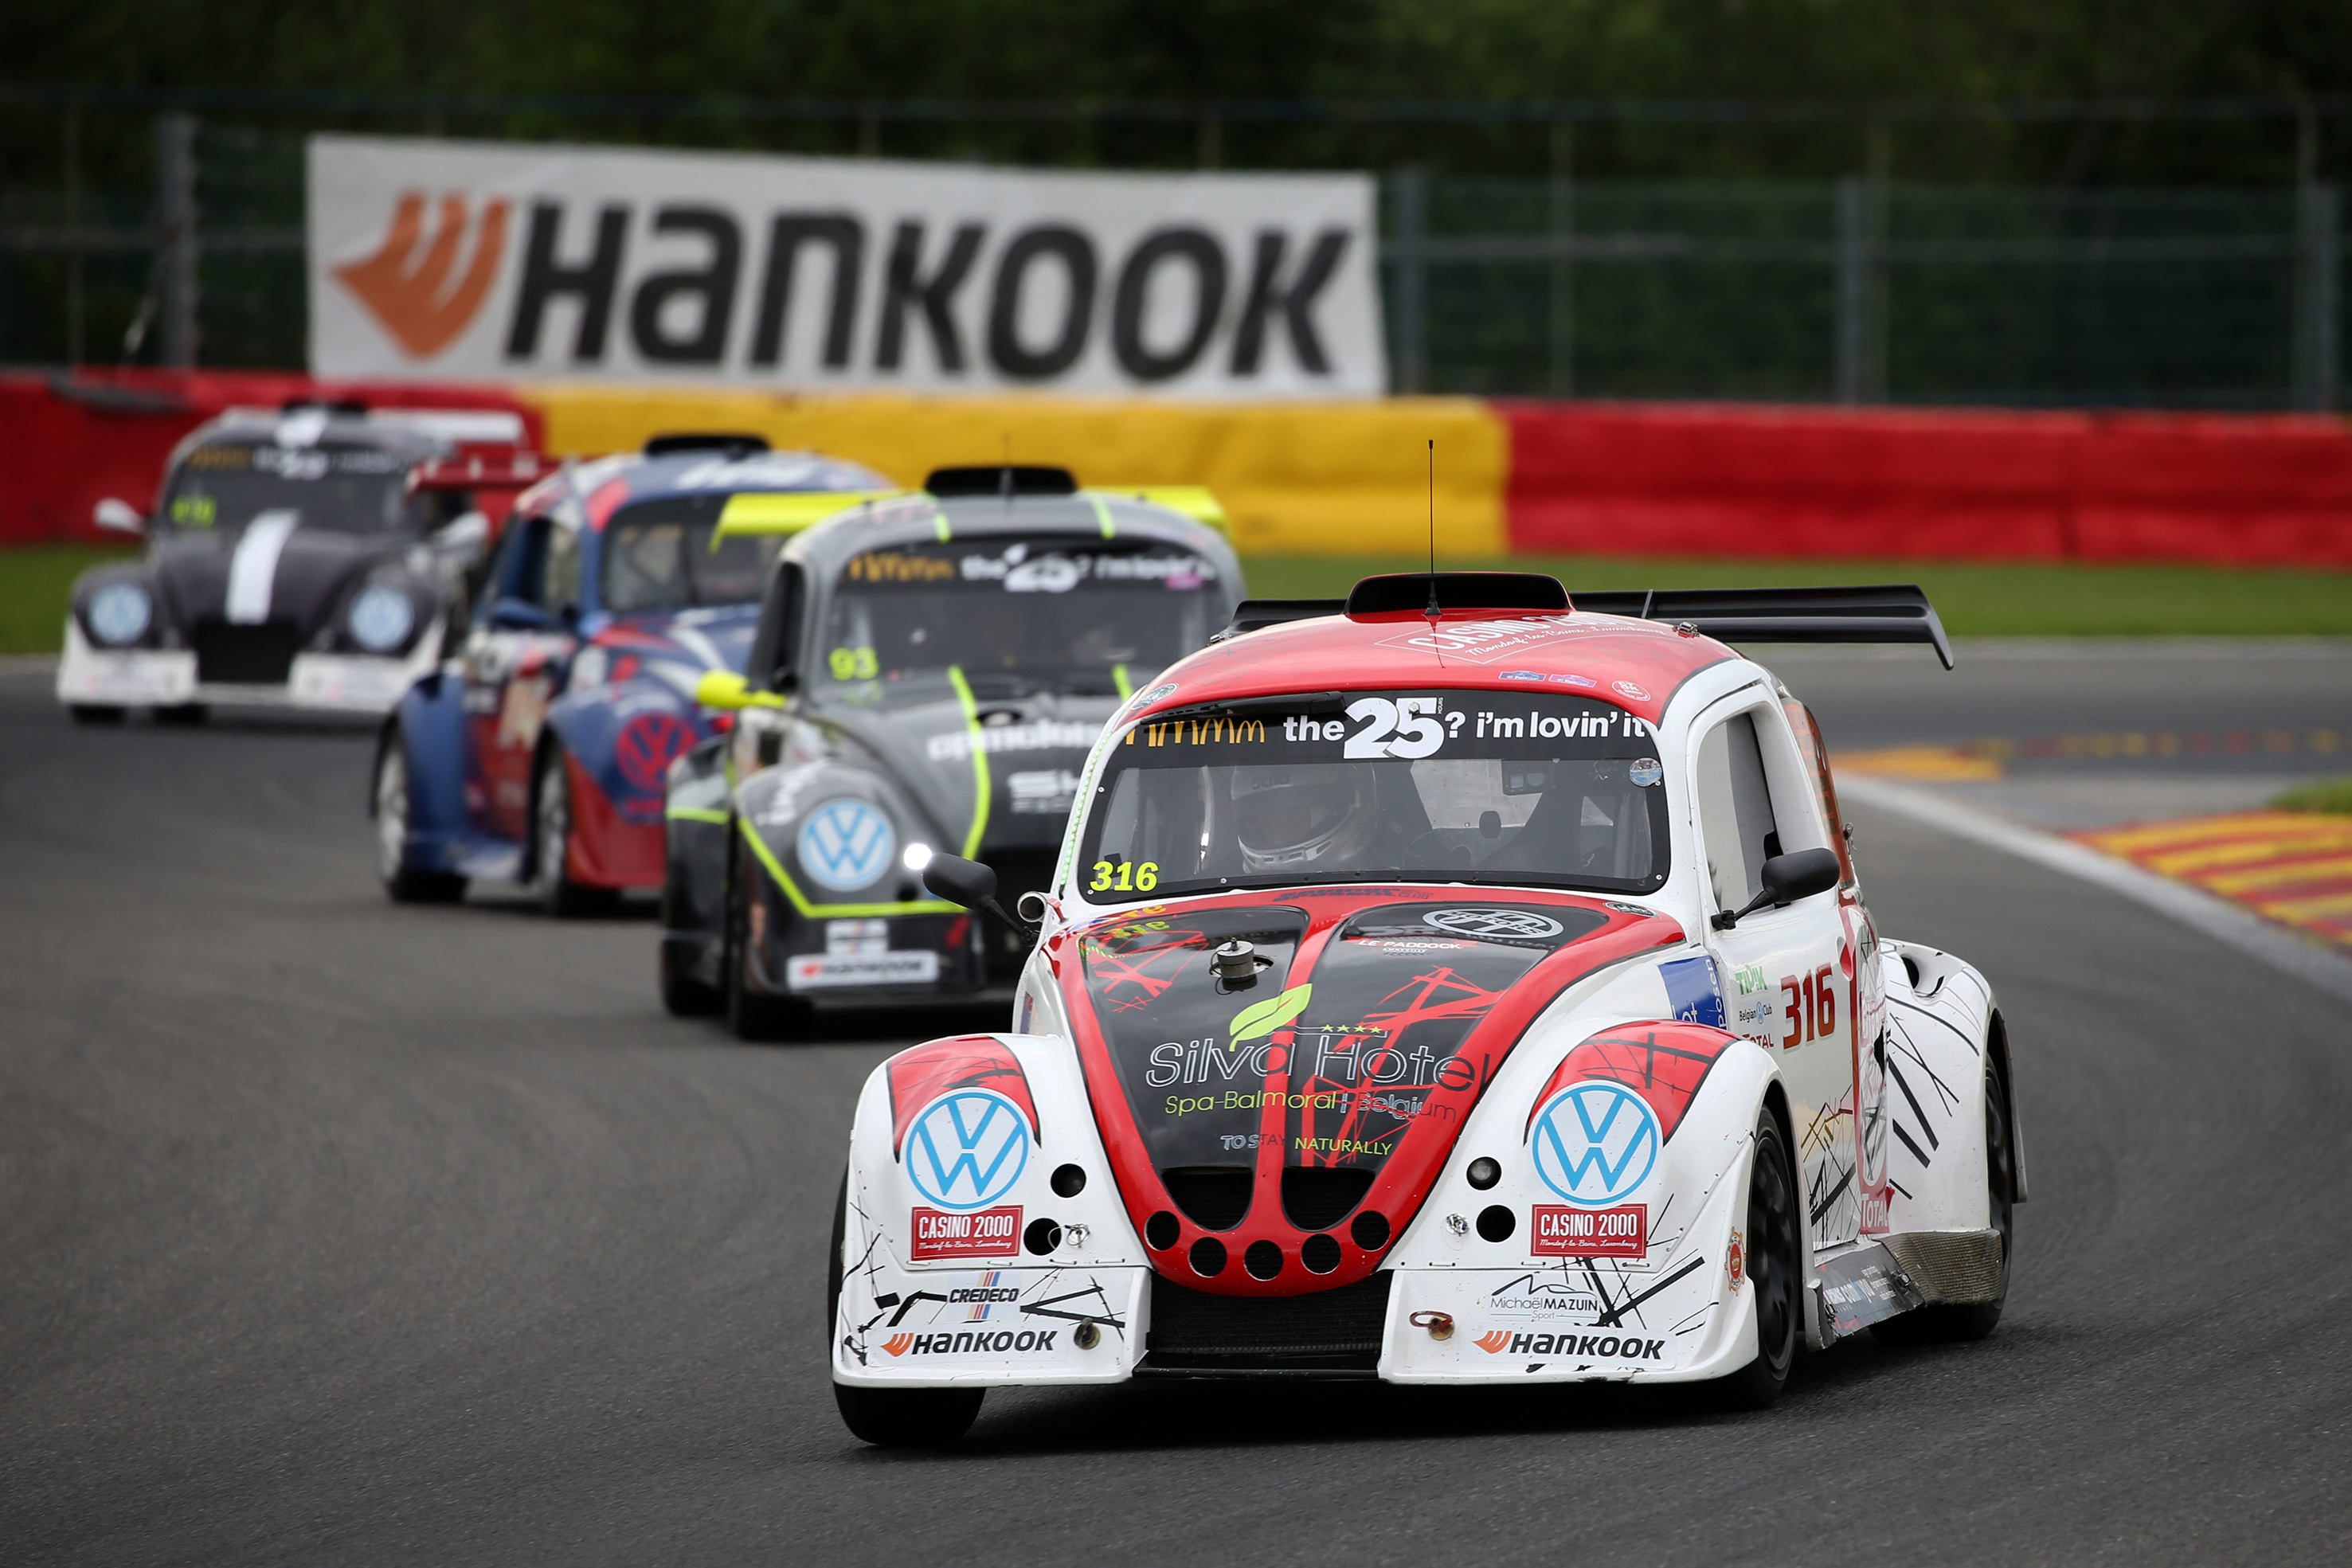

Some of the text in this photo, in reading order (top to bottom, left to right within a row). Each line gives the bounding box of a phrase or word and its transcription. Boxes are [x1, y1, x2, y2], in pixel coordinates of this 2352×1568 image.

[830, 647, 879, 680] 93
[1283, 715, 1345, 741] the
[1476, 711, 1524, 738] i'm
[1529, 711, 1618, 738] lovin'
[1622, 711, 1646, 737] it
[1090, 861, 1159, 892] 316
[1739, 1007, 1757, 1023] Belgian
[1780, 961, 1835, 1050] 316
[1145, 1034, 1490, 1092] Silva Hotel
[1164, 1089, 1457, 1122] Spa-Balmoral Belgium
[1220, 1134, 1392, 1155] TO STAY NATURALLY
[918, 1214, 1014, 1239] CASINO 2000
[1540, 1213, 1638, 1237] CASINO 2000
[949, 1288, 1019, 1304] CREDECO
[1532, 1310, 1555, 1321] Sport
